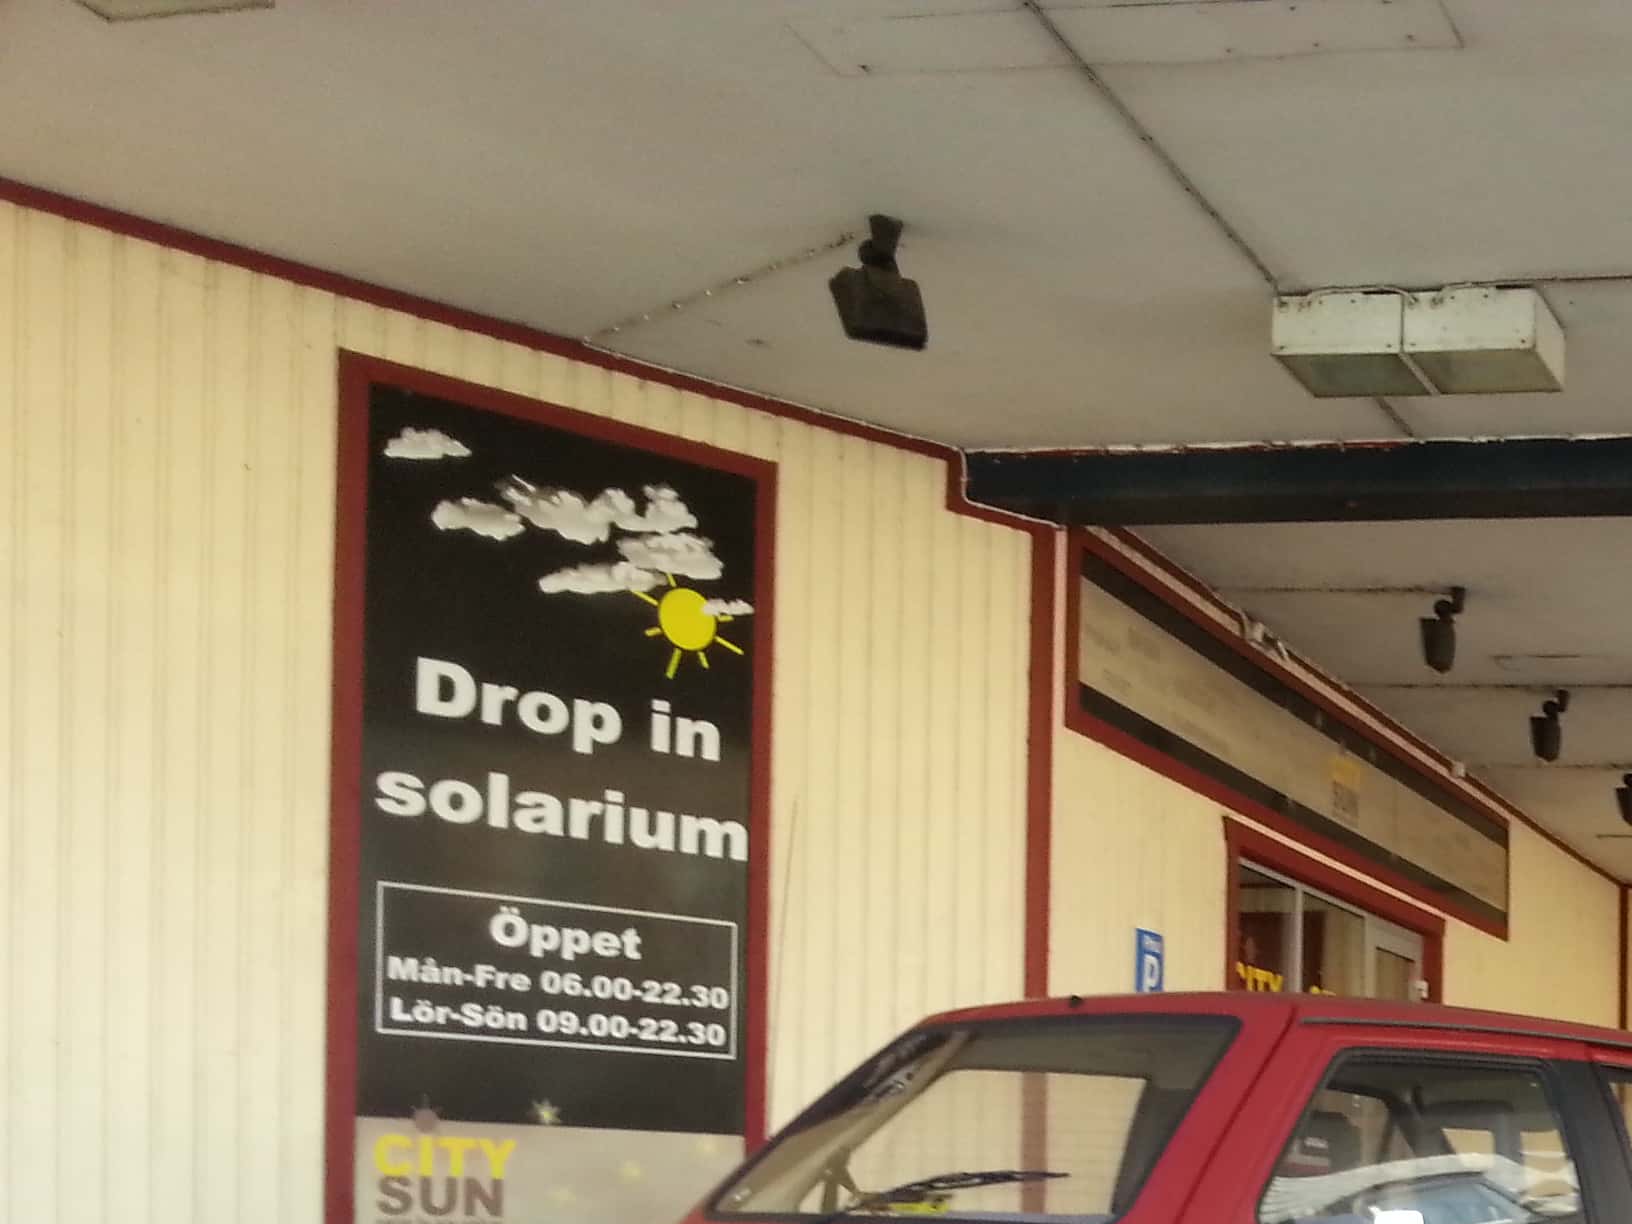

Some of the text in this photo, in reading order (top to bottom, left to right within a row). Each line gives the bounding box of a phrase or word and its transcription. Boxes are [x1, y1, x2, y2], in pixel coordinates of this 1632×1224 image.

[416, 656, 721, 762] Drop in
[375, 771, 748, 862] solarium
[489, 905, 642, 960] Öppet
[386, 955, 729, 1010] Mån-Fre 06.00-22.30
[389, 996, 727, 1047] Lör-Sön 09.00-22.30
[374, 1134, 517, 1179] CITY
[377, 1176, 504, 1216] SUN
